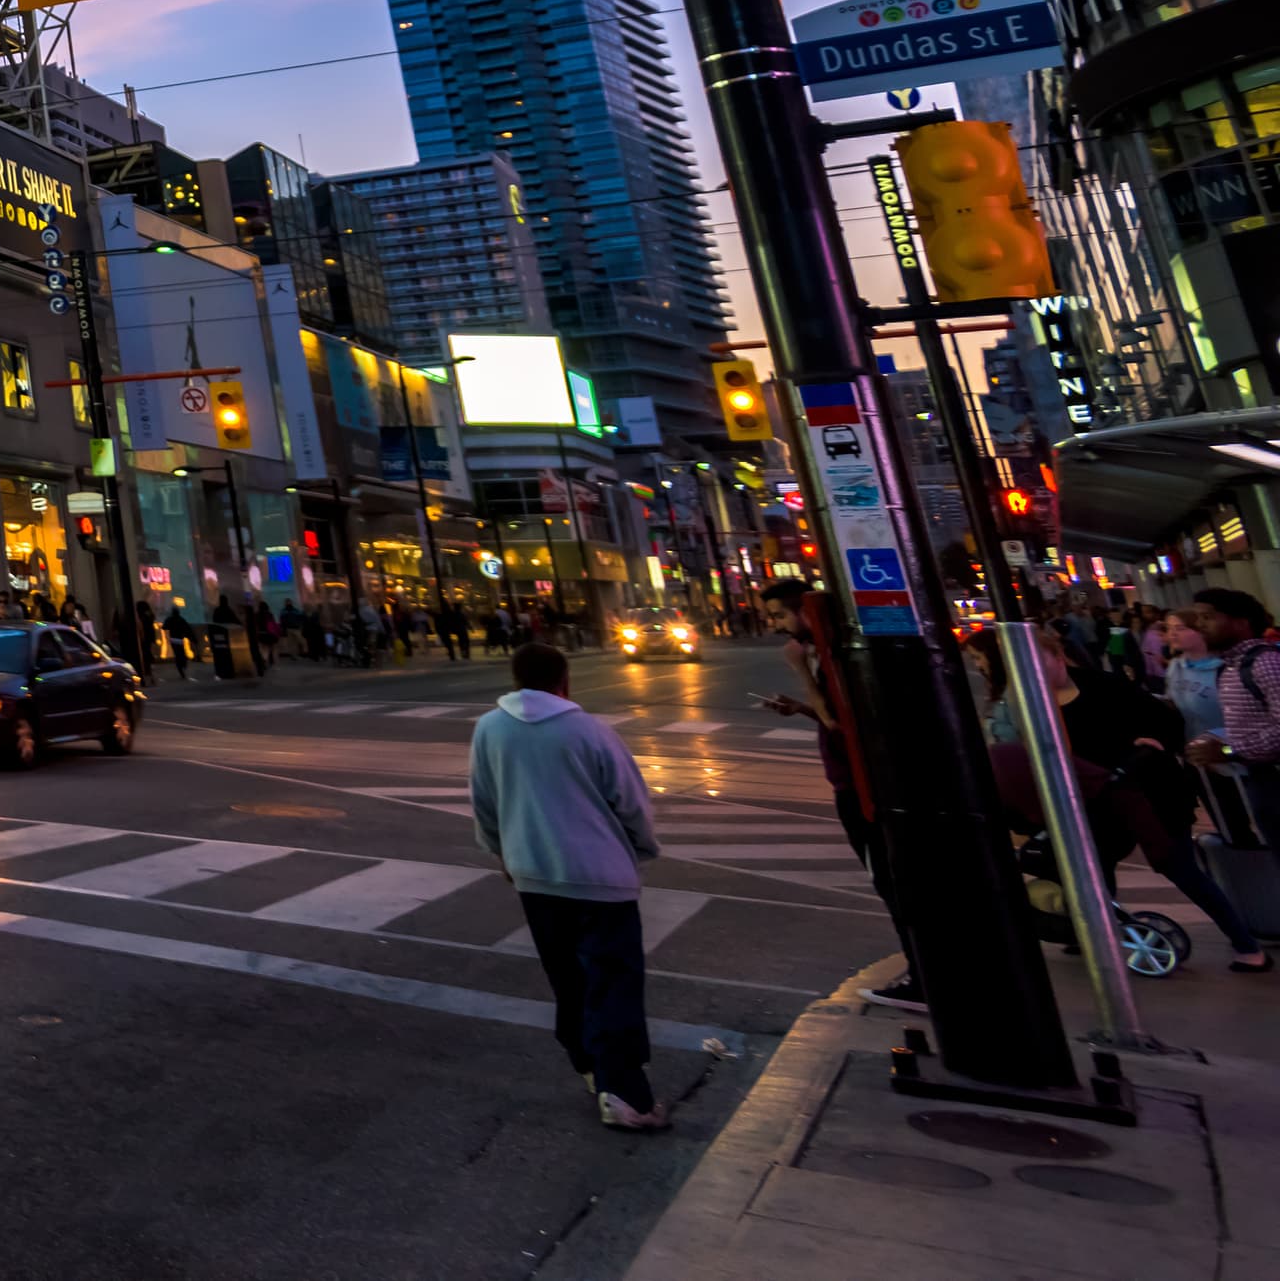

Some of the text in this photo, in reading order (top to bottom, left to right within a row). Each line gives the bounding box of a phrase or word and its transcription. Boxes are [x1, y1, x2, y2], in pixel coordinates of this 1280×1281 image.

[819, 14, 1029, 73] Dundas St E
[6, 159, 22, 196] IT.
[22, 166, 62, 213] SHARE
[61, 184, 77, 218] IT.
[873, 163, 918, 269] DOWNTOWN
